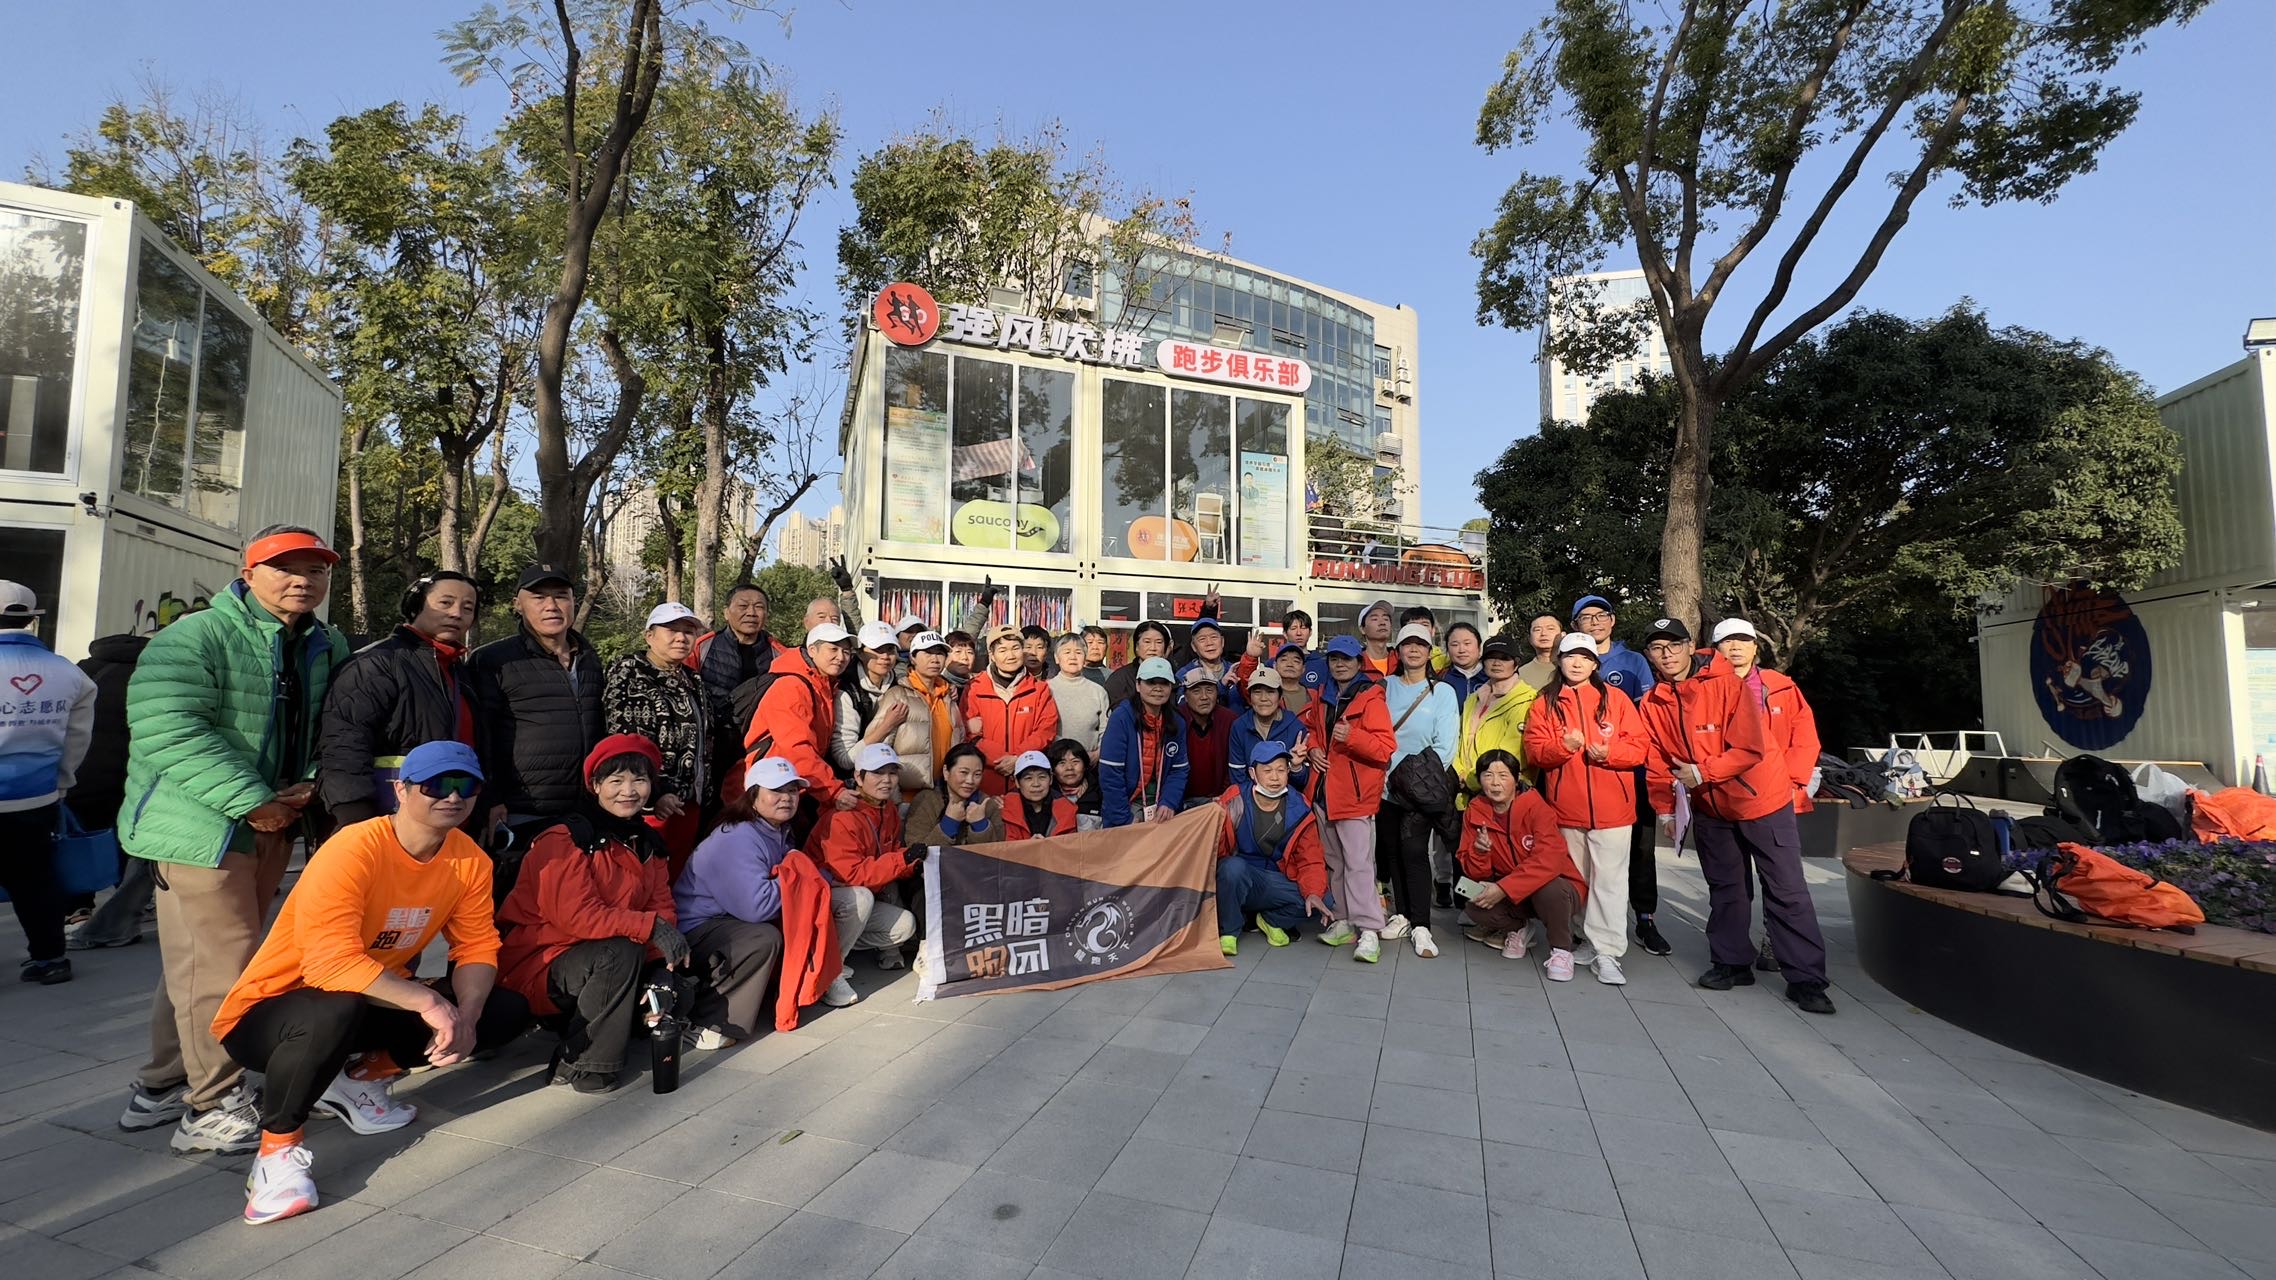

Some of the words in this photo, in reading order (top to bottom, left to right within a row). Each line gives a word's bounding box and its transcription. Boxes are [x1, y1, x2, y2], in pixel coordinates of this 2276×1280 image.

[944, 303, 1147, 367] 强风吹拂
[1172, 344, 1300, 387] 跑步俱乐部
[1311, 559, 1421, 586] RUNNING
[1421, 566, 1486, 591] CLUB
[0, 700, 67, 714] 心志愿队
[963, 897, 1050, 949] 黑暗
